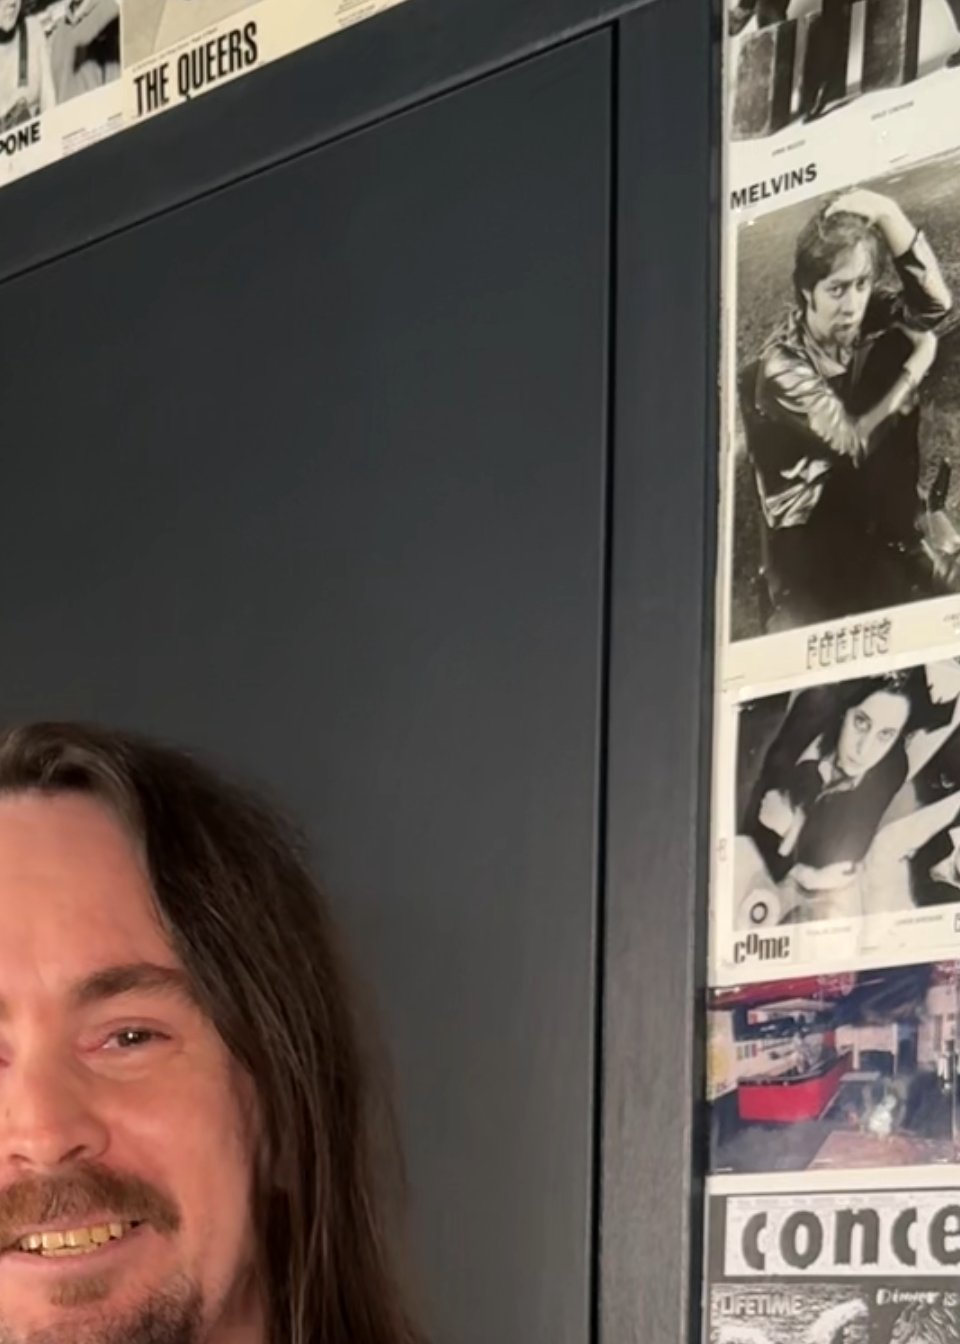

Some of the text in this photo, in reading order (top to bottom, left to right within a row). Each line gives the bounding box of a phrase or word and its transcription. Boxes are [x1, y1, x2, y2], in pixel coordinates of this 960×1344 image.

[134, 21, 259, 116] THE QUEERS
[730, 162, 818, 210] MELVINS
